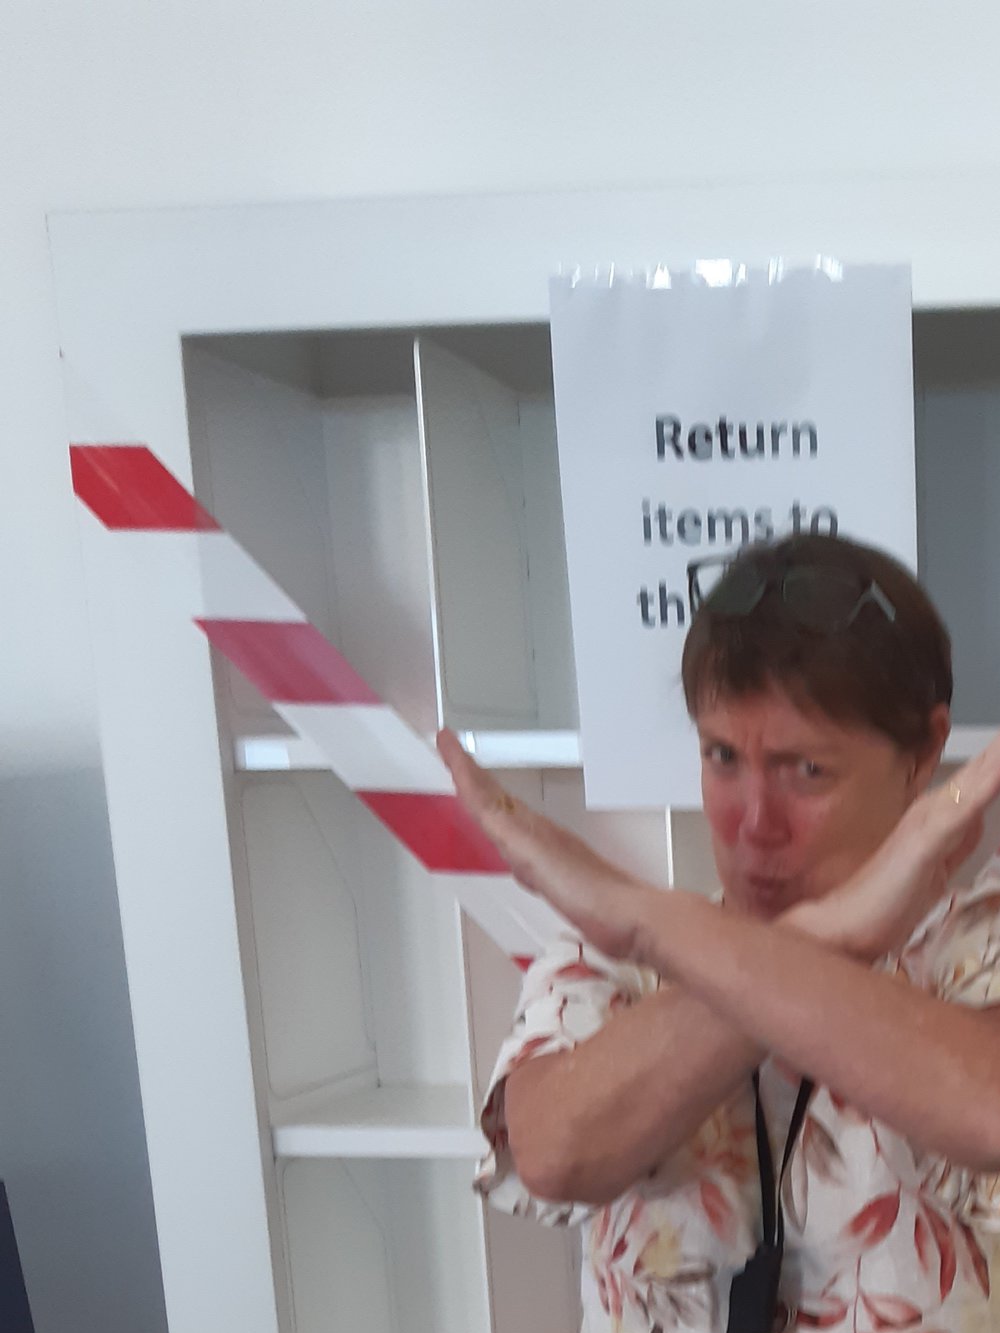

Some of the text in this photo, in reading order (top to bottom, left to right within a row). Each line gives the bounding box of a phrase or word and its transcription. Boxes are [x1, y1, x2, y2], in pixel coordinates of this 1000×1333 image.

[655, 413, 818, 463] Return
[641, 497, 839, 548] items to
[637, 579, 692, 628] th
